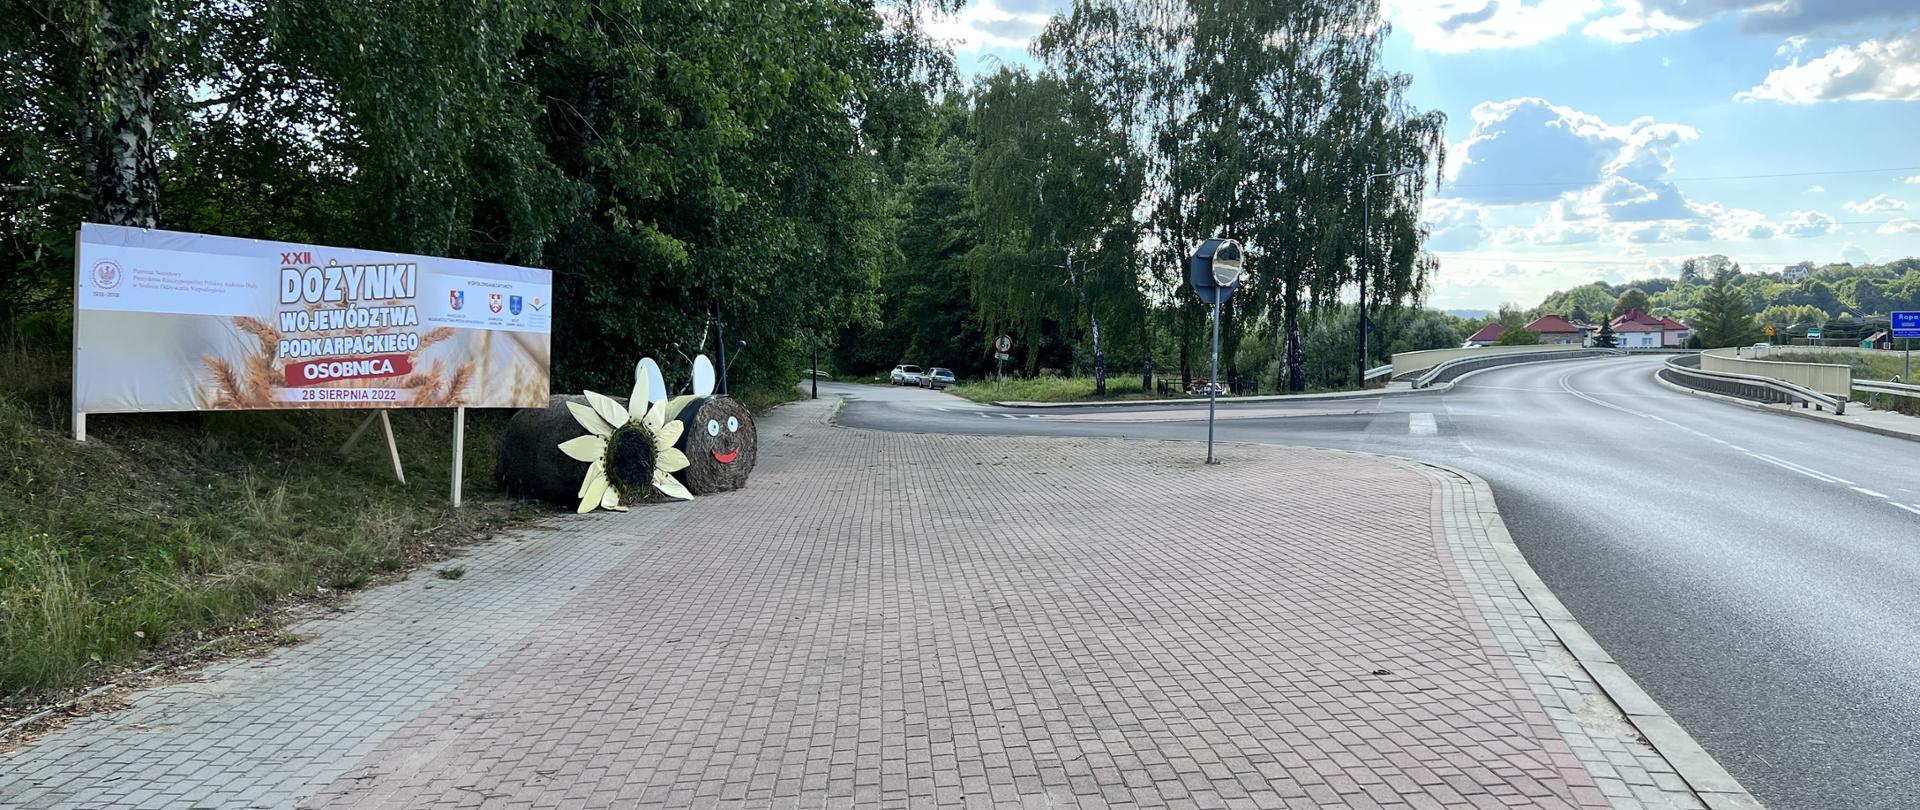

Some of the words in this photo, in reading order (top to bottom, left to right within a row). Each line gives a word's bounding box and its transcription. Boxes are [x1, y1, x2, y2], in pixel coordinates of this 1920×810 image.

[281, 252, 311, 265] XXII
[280, 259, 417, 304] DOŻYNKI
[279, 303, 418, 333] WOJEWÓDZTWA
[279, 332, 419, 359] PODKARPACKIEGO
[303, 359, 394, 380] OSOBNICA
[302, 390, 316, 400] 28
[318, 389, 369, 400] SIERPNIA
[371, 390, 396, 400] 2022
